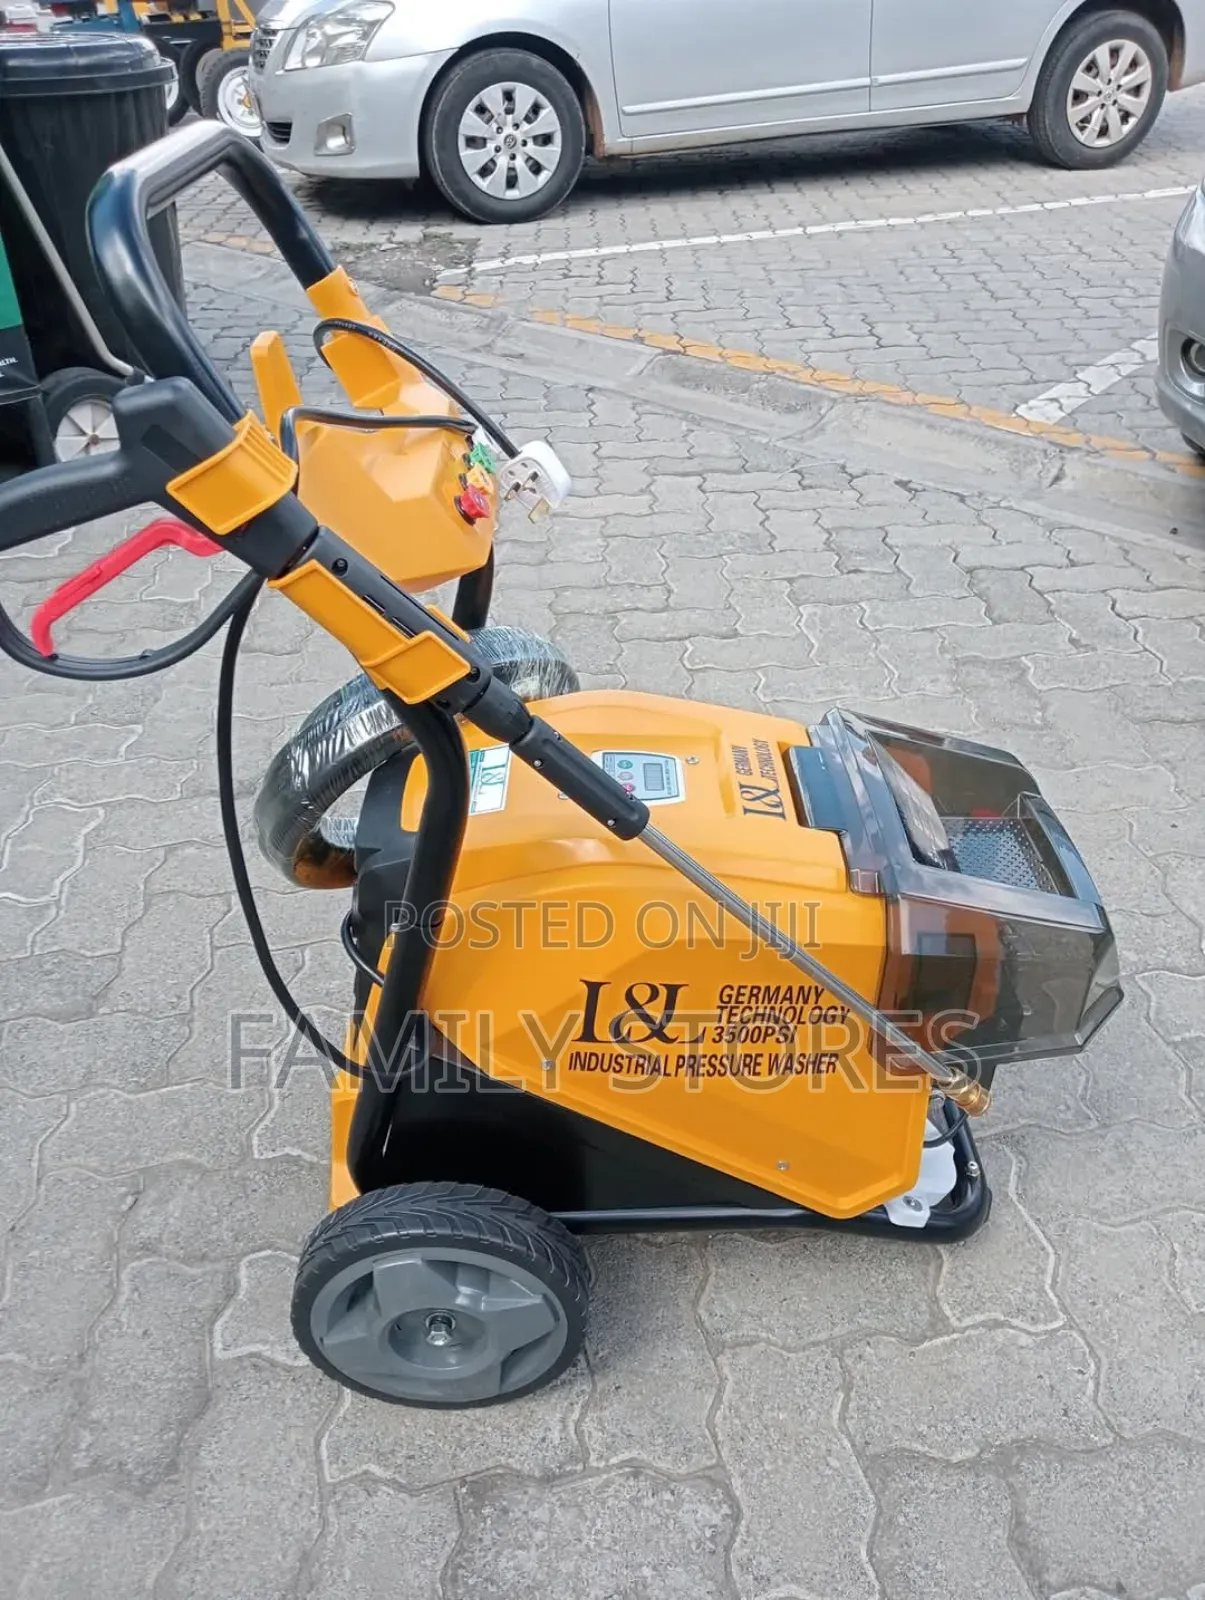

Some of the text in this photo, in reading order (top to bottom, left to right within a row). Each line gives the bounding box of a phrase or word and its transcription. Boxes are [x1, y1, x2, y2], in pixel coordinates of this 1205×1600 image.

[731, 744, 753, 776] GERMANY
[751, 737, 778, 779] TECHNOLOGY
[718, 984, 826, 1005] GERMANY
[715, 1004, 851, 1025] TECHNOLOGY
[711, 1025, 799, 1045] 3500PSI
[568, 1051, 839, 1077] INDUSTRIAL PRESSURE WASHER
